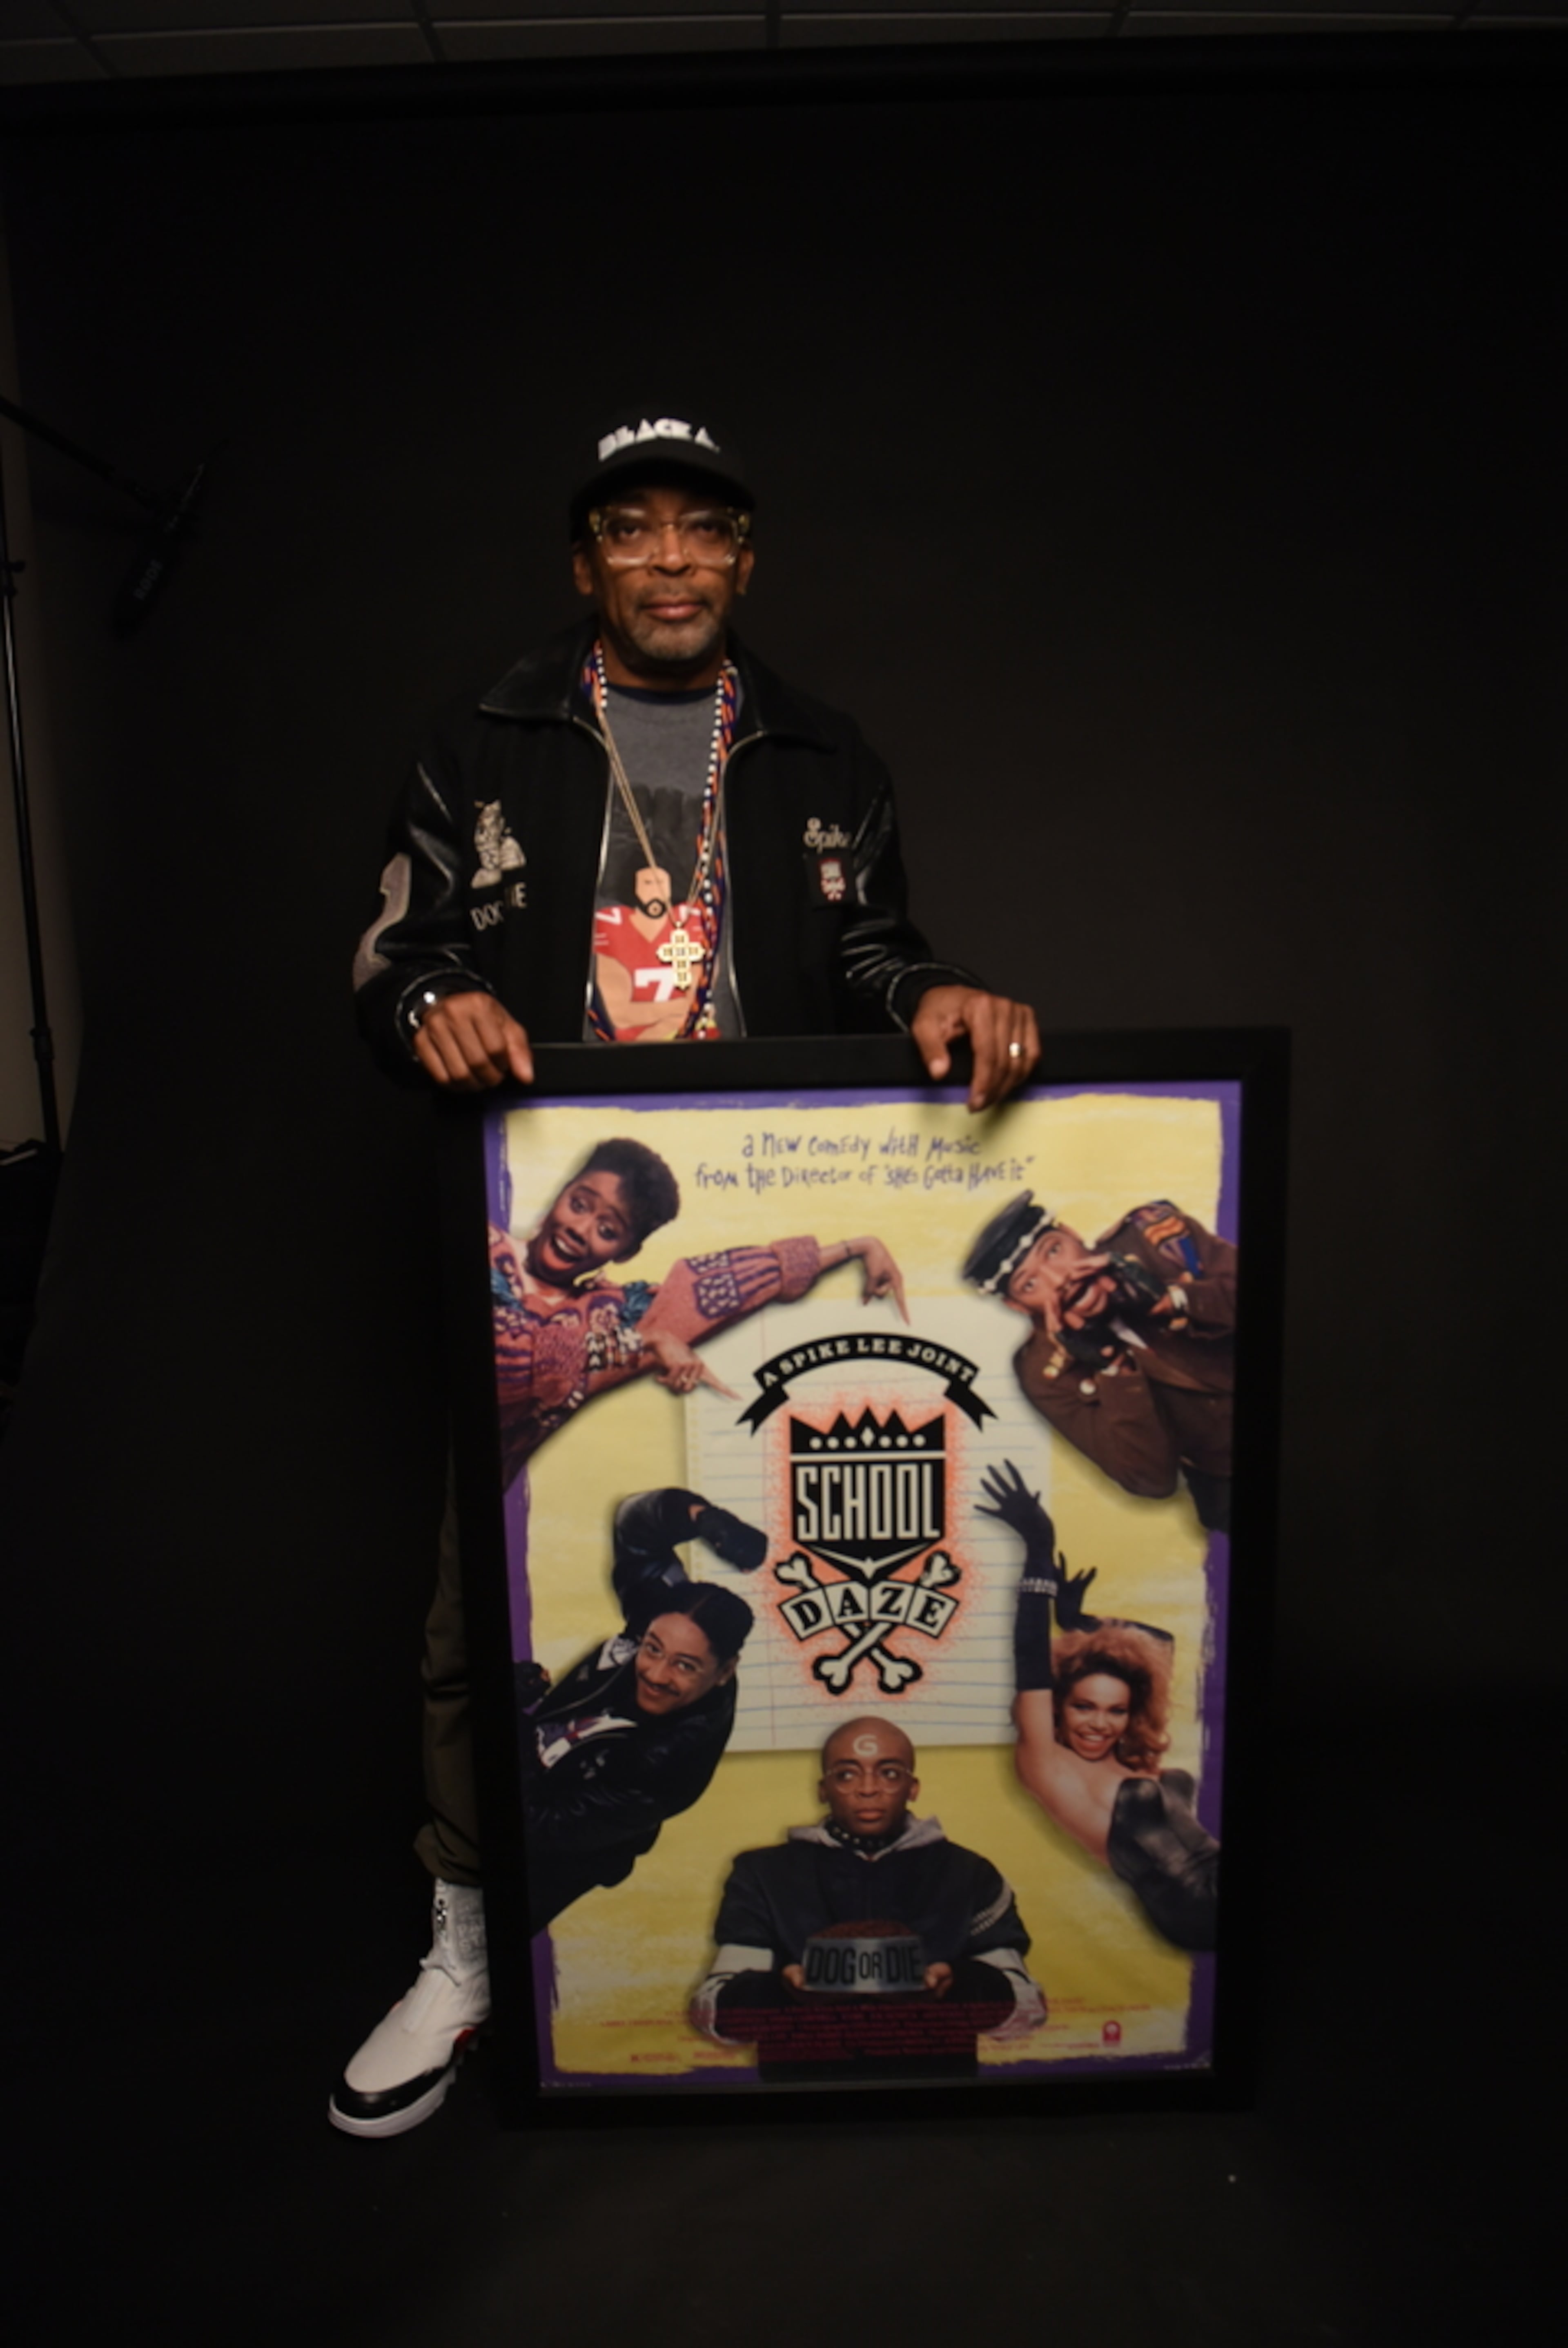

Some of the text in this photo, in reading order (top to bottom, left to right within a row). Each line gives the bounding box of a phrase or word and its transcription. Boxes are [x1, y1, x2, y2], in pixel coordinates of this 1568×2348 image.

[762, 1338, 977, 1387] A SPIKE LEE JOINT
[796, 1464, 940, 1541] SCHOOL
[791, 1586, 946, 1632] DAZE
[807, 1945, 924, 1985] DOG OR DIE
